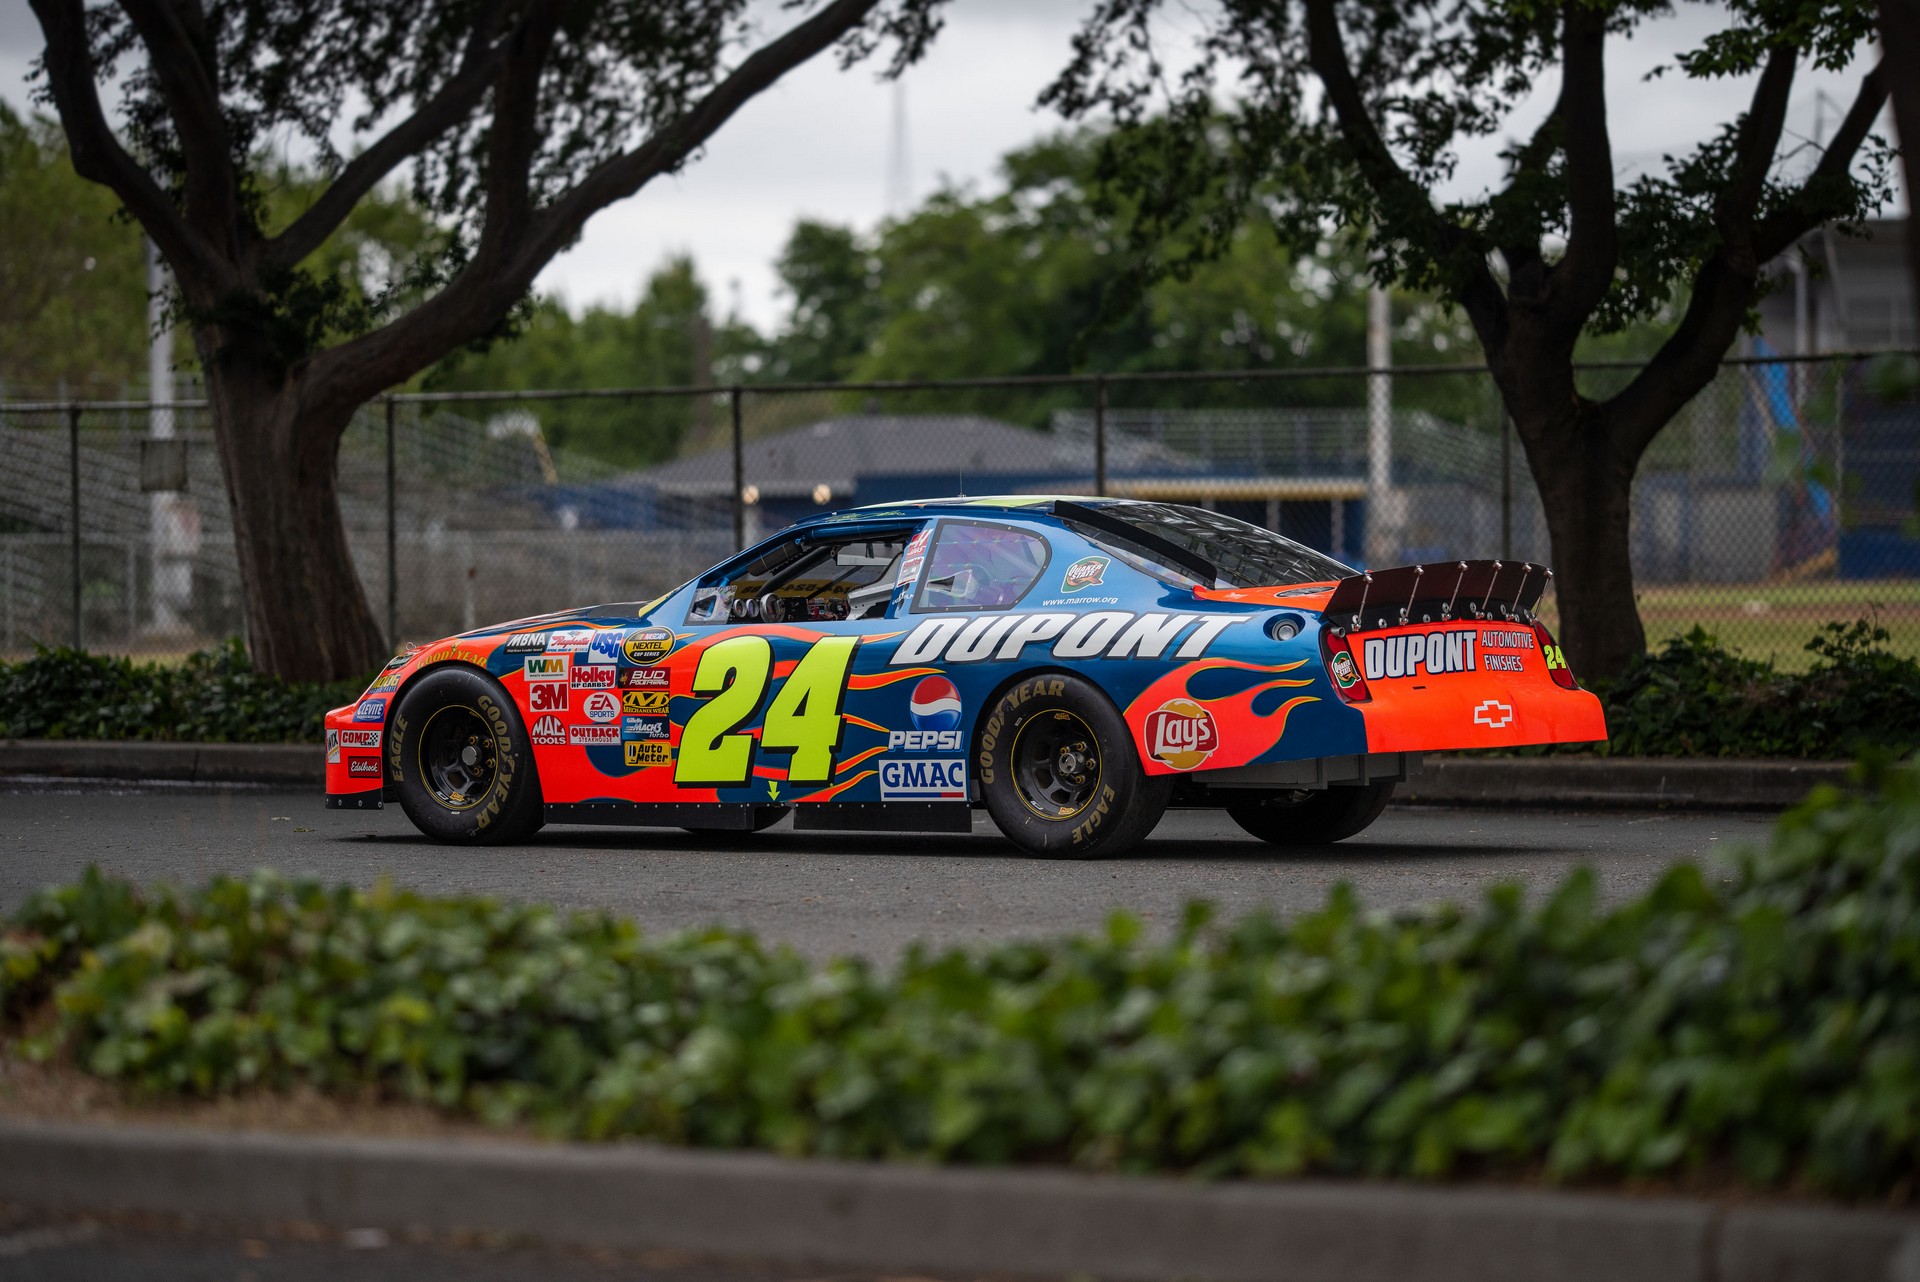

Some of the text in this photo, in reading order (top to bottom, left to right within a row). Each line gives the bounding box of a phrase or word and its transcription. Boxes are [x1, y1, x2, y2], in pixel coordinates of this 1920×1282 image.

[1068, 563, 1104, 577] QUAKER
[1070, 570, 1096, 580] STATE
[1042, 596, 1119, 607] www.marrow.org
[506, 632, 546, 647] MBNA
[551, 635, 590, 648] Raybestos
[643, 632, 668, 640] NASCAR
[888, 611, 1253, 667] DUPONT
[1481, 630, 1535, 649] AUTOMOTIVE
[592, 632, 623, 659] USG
[633, 642, 664, 650] NEXTEL
[1364, 630, 1477, 681] DUPONT
[1543, 644, 1567, 670] 24
[528, 659, 564, 673] WM
[1483, 654, 1524, 672] FINISHES
[571, 667, 615, 687] Holley
[632, 670, 666, 679] BUD
[531, 683, 568, 711] 3M
[589, 694, 614, 710] EA
[357, 702, 384, 716] CLEVITE
[589, 710, 615, 718] SPORTS
[623, 705, 670, 714] MECHANIX WEAR
[673, 635, 864, 786] 24
[532, 715, 566, 736] MAC
[571, 727, 619, 738] OUTBACK
[632, 722, 663, 733] MACH3
[979, 680, 1065, 784] GOODYEAR
[342, 732, 370, 744] COMP
[532, 736, 567, 745] TOOLS
[649, 731, 670, 739] Turbo
[888, 730, 964, 752] PEPSI
[1154, 713, 1211, 756] Lay's
[390, 713, 409, 782] EAGLE
[638, 744, 663, 753] Auto
[477, 694, 516, 829] GOODYEAR
[637, 753, 669, 763] Meter
[350, 761, 379, 773] Edelbrock
[882, 762, 964, 788] GMAC
[1072, 783, 1116, 845] EAGLE
